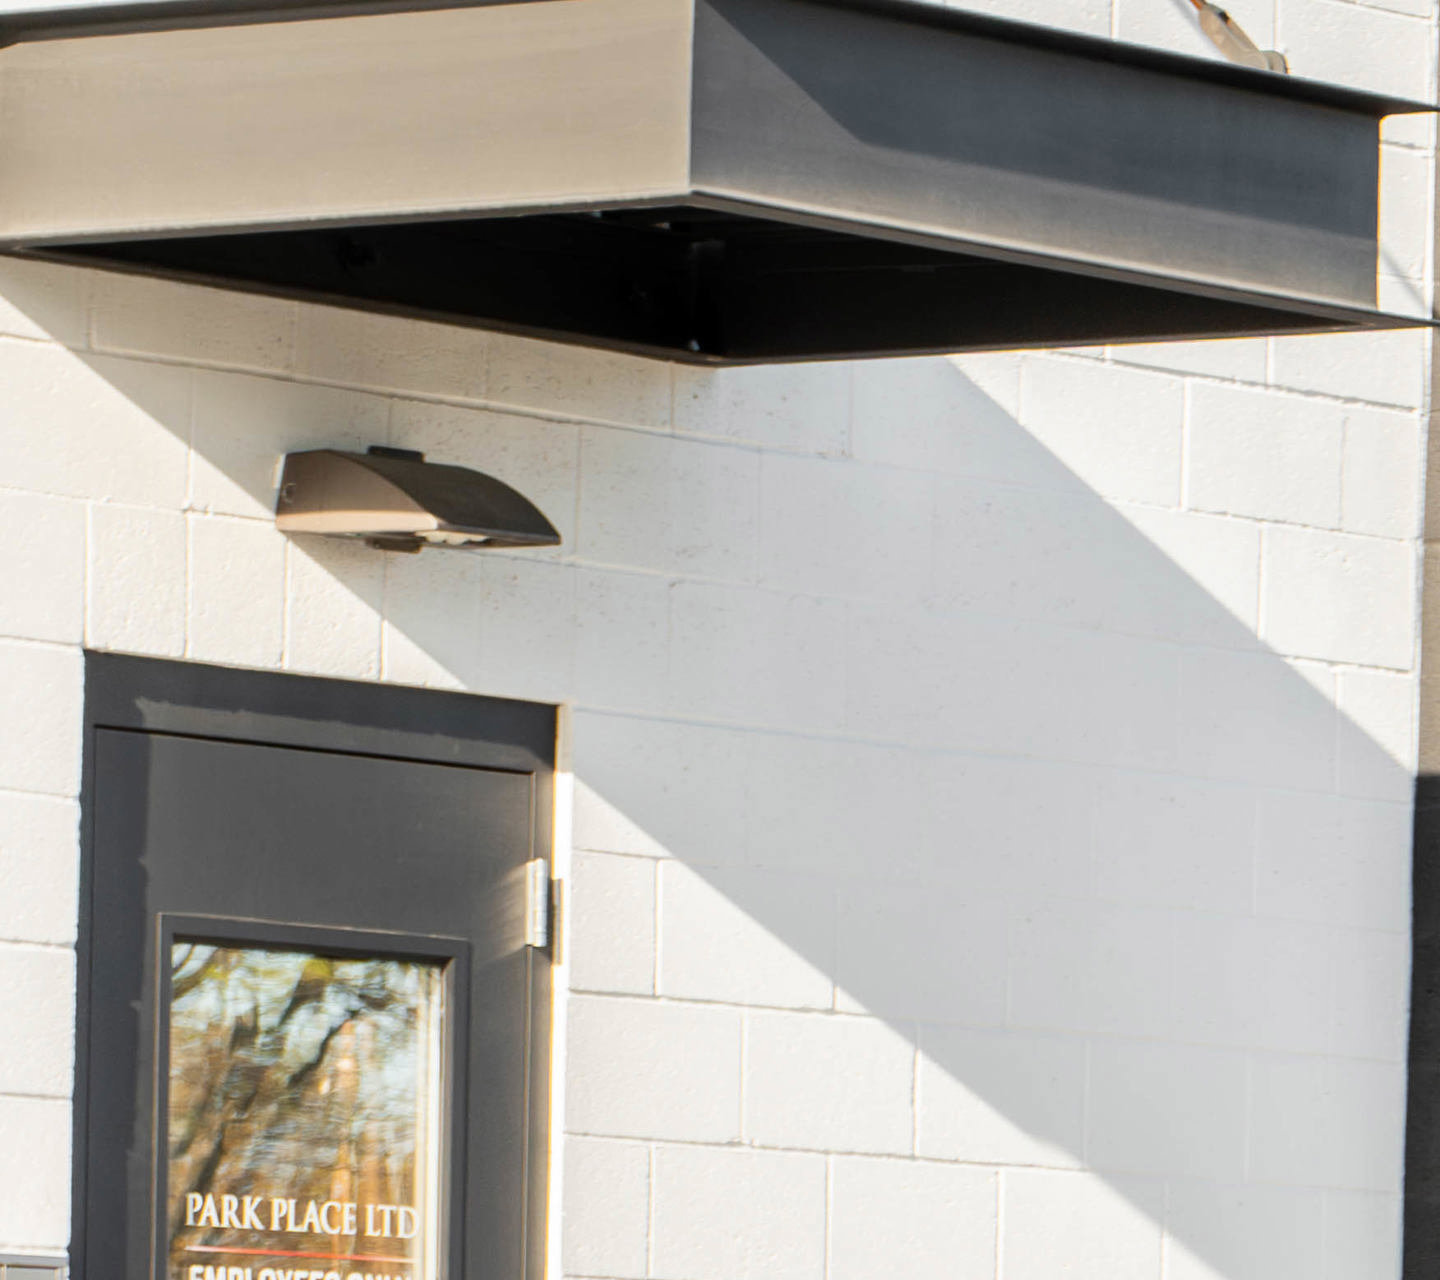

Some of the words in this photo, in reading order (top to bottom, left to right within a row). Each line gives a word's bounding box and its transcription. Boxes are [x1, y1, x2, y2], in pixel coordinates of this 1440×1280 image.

[185, 1191, 266, 1231] PARK
[269, 1197, 357, 1236] PLACE
[364, 1203, 420, 1239] LTD
